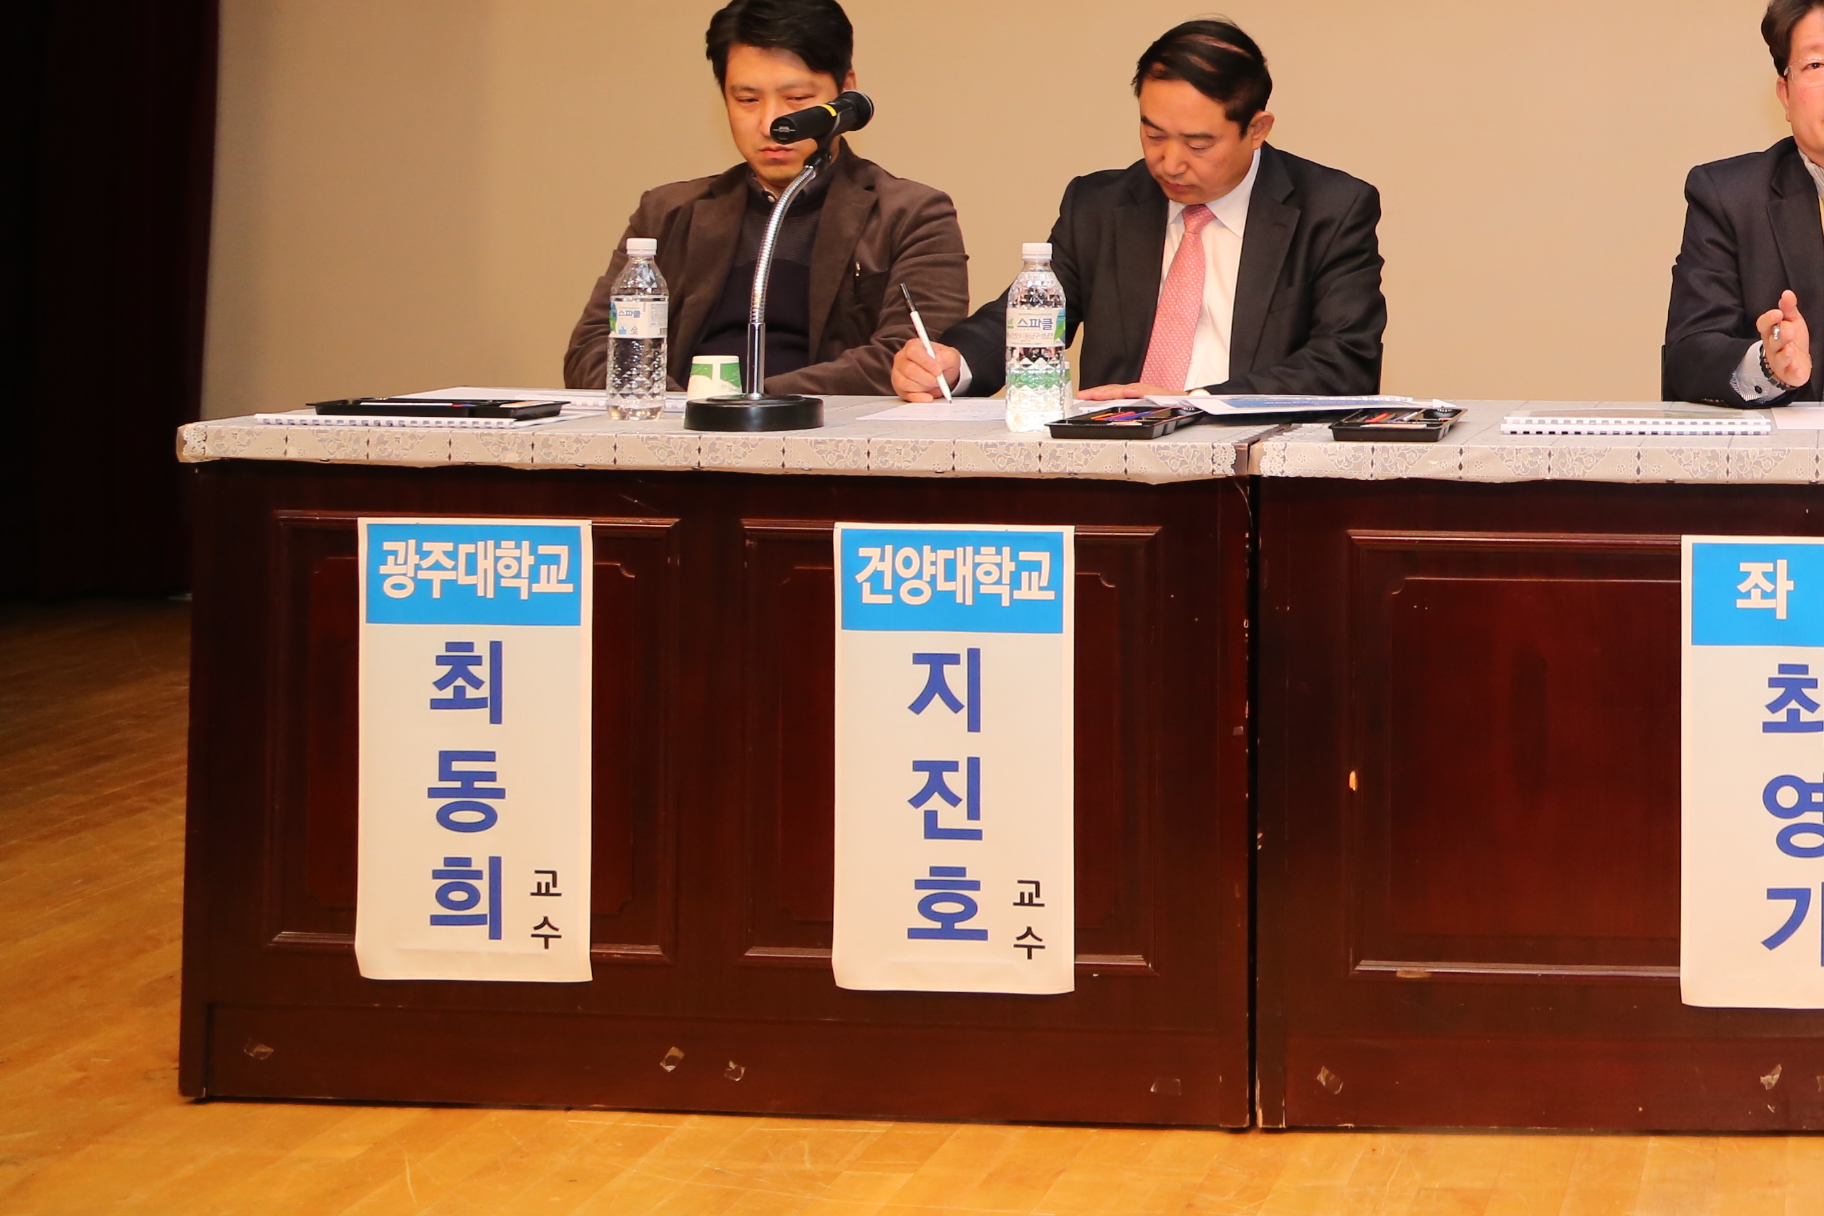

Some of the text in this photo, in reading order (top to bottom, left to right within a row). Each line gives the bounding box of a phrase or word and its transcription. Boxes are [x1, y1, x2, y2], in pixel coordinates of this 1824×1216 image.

[1016, 316, 1054, 332] 스파클
[379, 539, 574, 600] 광주대학교
[854, 544, 1056, 607] 건양대학교
[428, 640, 505, 940] 최동희
[908, 647, 988, 940] 지진호
[530, 870, 562, 950] 교수
[1013, 880, 1046, 960] 교수
